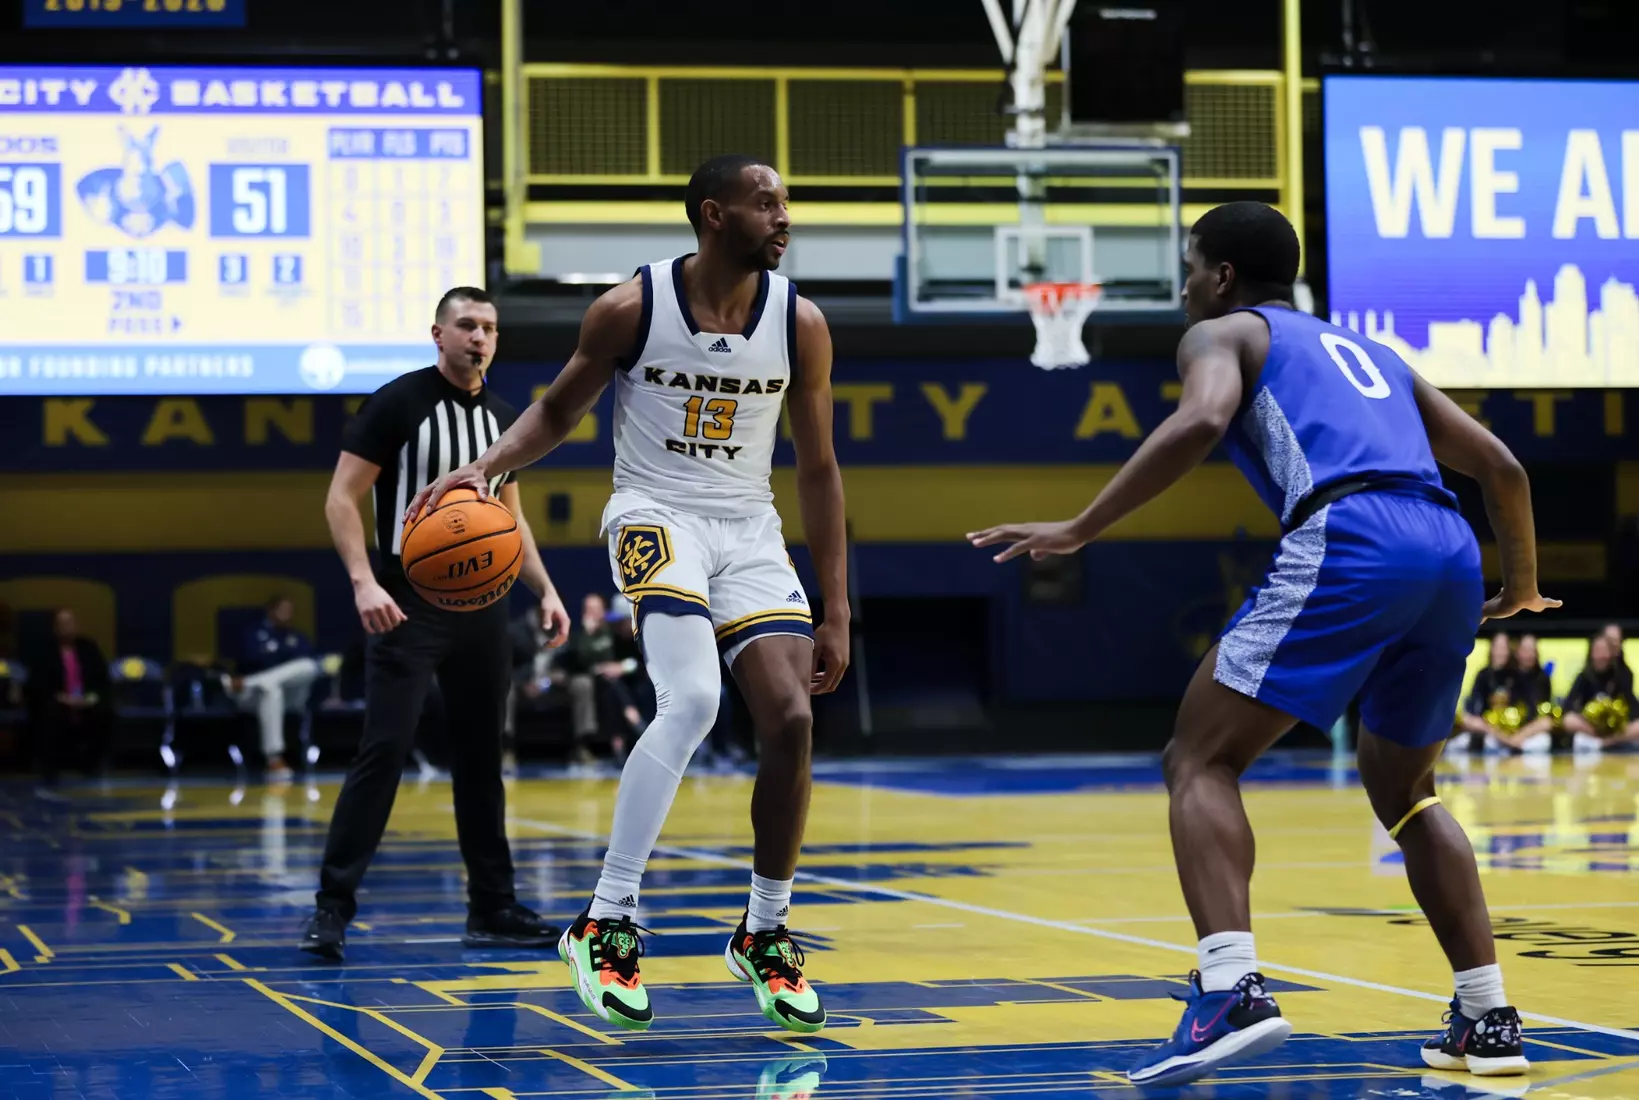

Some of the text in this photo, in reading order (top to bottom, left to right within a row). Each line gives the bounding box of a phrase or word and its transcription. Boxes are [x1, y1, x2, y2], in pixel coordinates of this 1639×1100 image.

[0, 79, 97, 105] CITY
[171, 80, 464, 108] BASKETBALL
[232, 167, 287, 234] 51
[1359, 126, 1526, 239] WE
[643, 366, 784, 395] KANSAS
[1320, 332, 1391, 399] 0
[683, 395, 738, 440] 13
[665, 439, 743, 460] CITY
